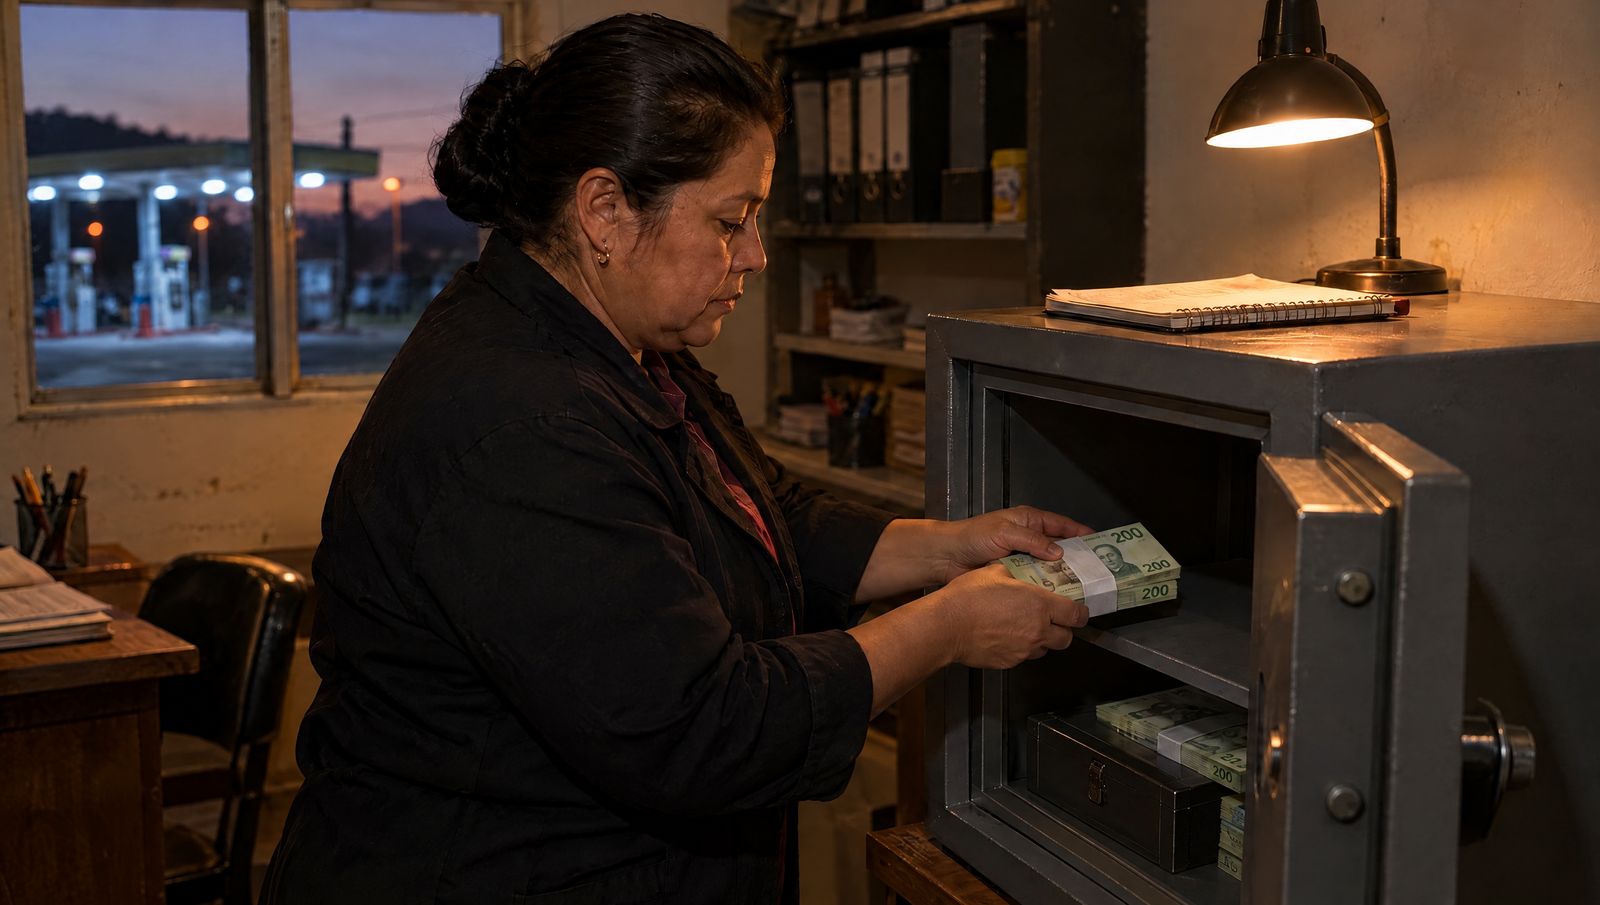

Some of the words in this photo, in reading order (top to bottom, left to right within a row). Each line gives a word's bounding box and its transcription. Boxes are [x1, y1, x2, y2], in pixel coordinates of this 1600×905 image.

[1111, 527, 1143, 543] 200
[1142, 560, 1171, 573] 200
[1142, 584, 1169, 600] 200
[1213, 765, 1233, 783] 200
